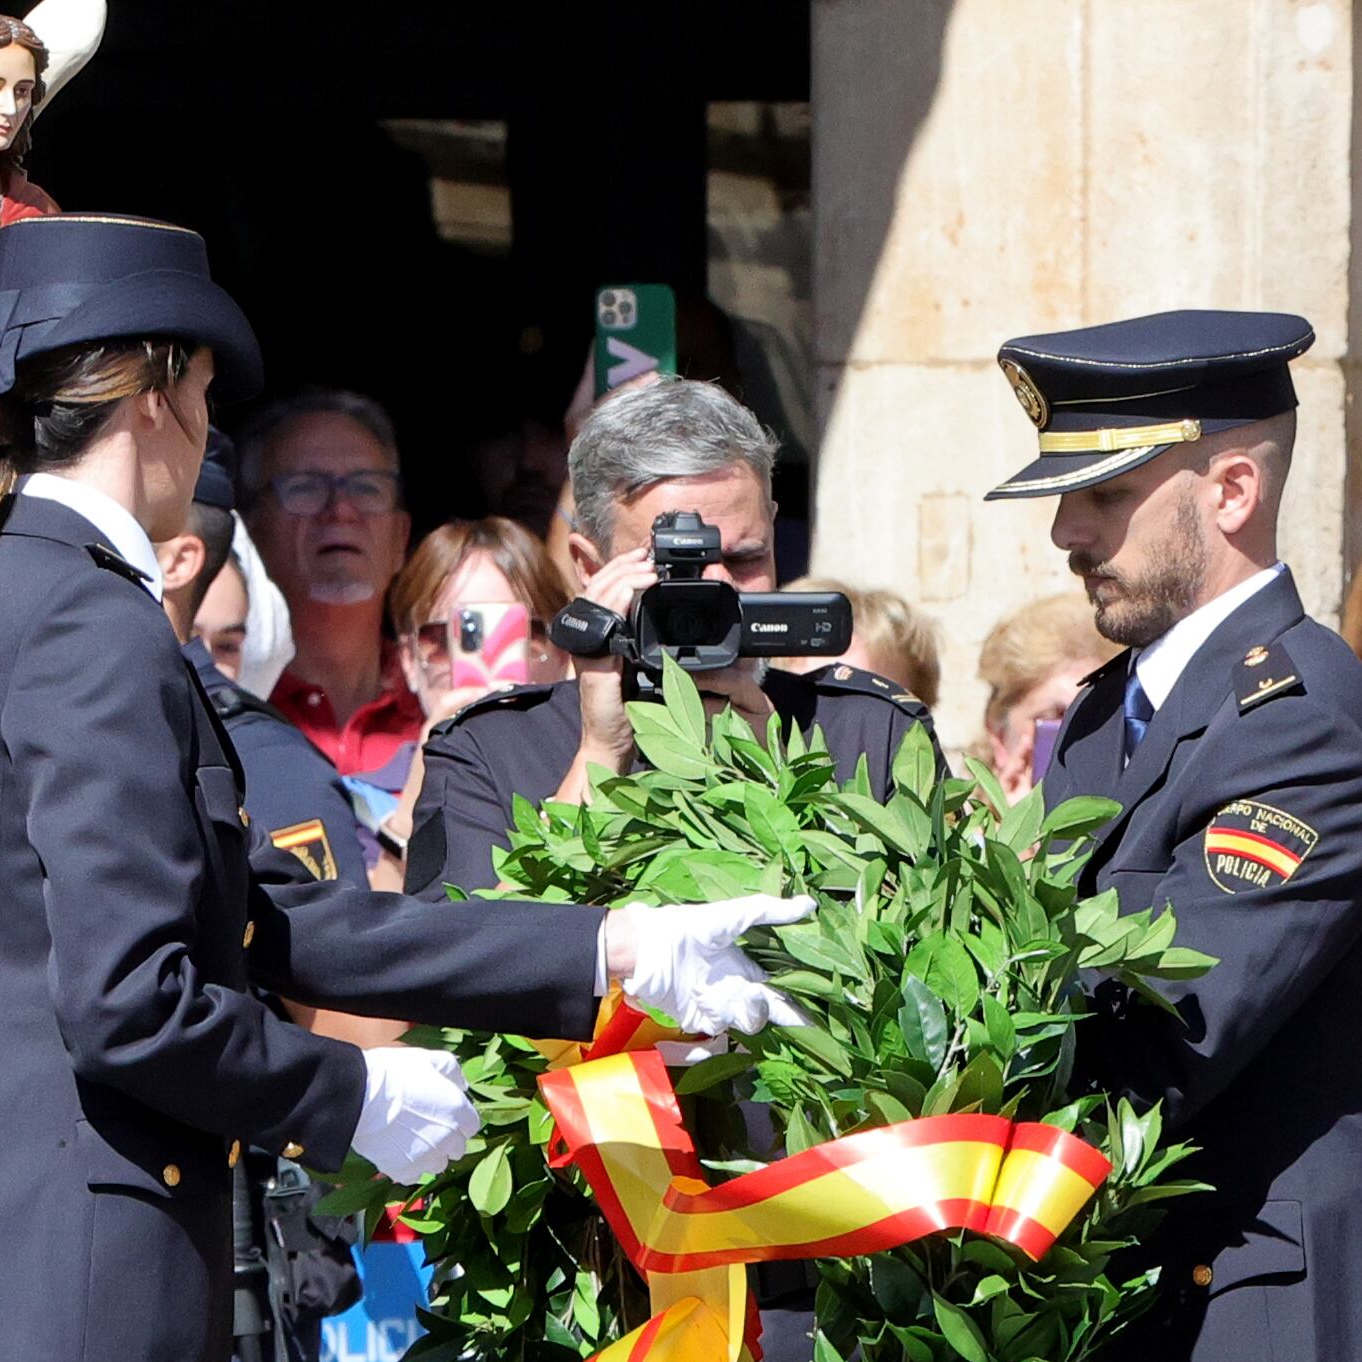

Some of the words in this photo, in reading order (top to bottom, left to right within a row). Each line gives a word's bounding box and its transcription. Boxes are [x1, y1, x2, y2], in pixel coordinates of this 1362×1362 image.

[673, 537, 704, 546] Canon
[560, 613, 589, 633] Canon
[750, 622, 789, 633] Canon
[1250, 819, 1269, 834] DE
[1255, 809, 1311, 845] NACIONAL
[1216, 854, 1272, 888] POLICIA
